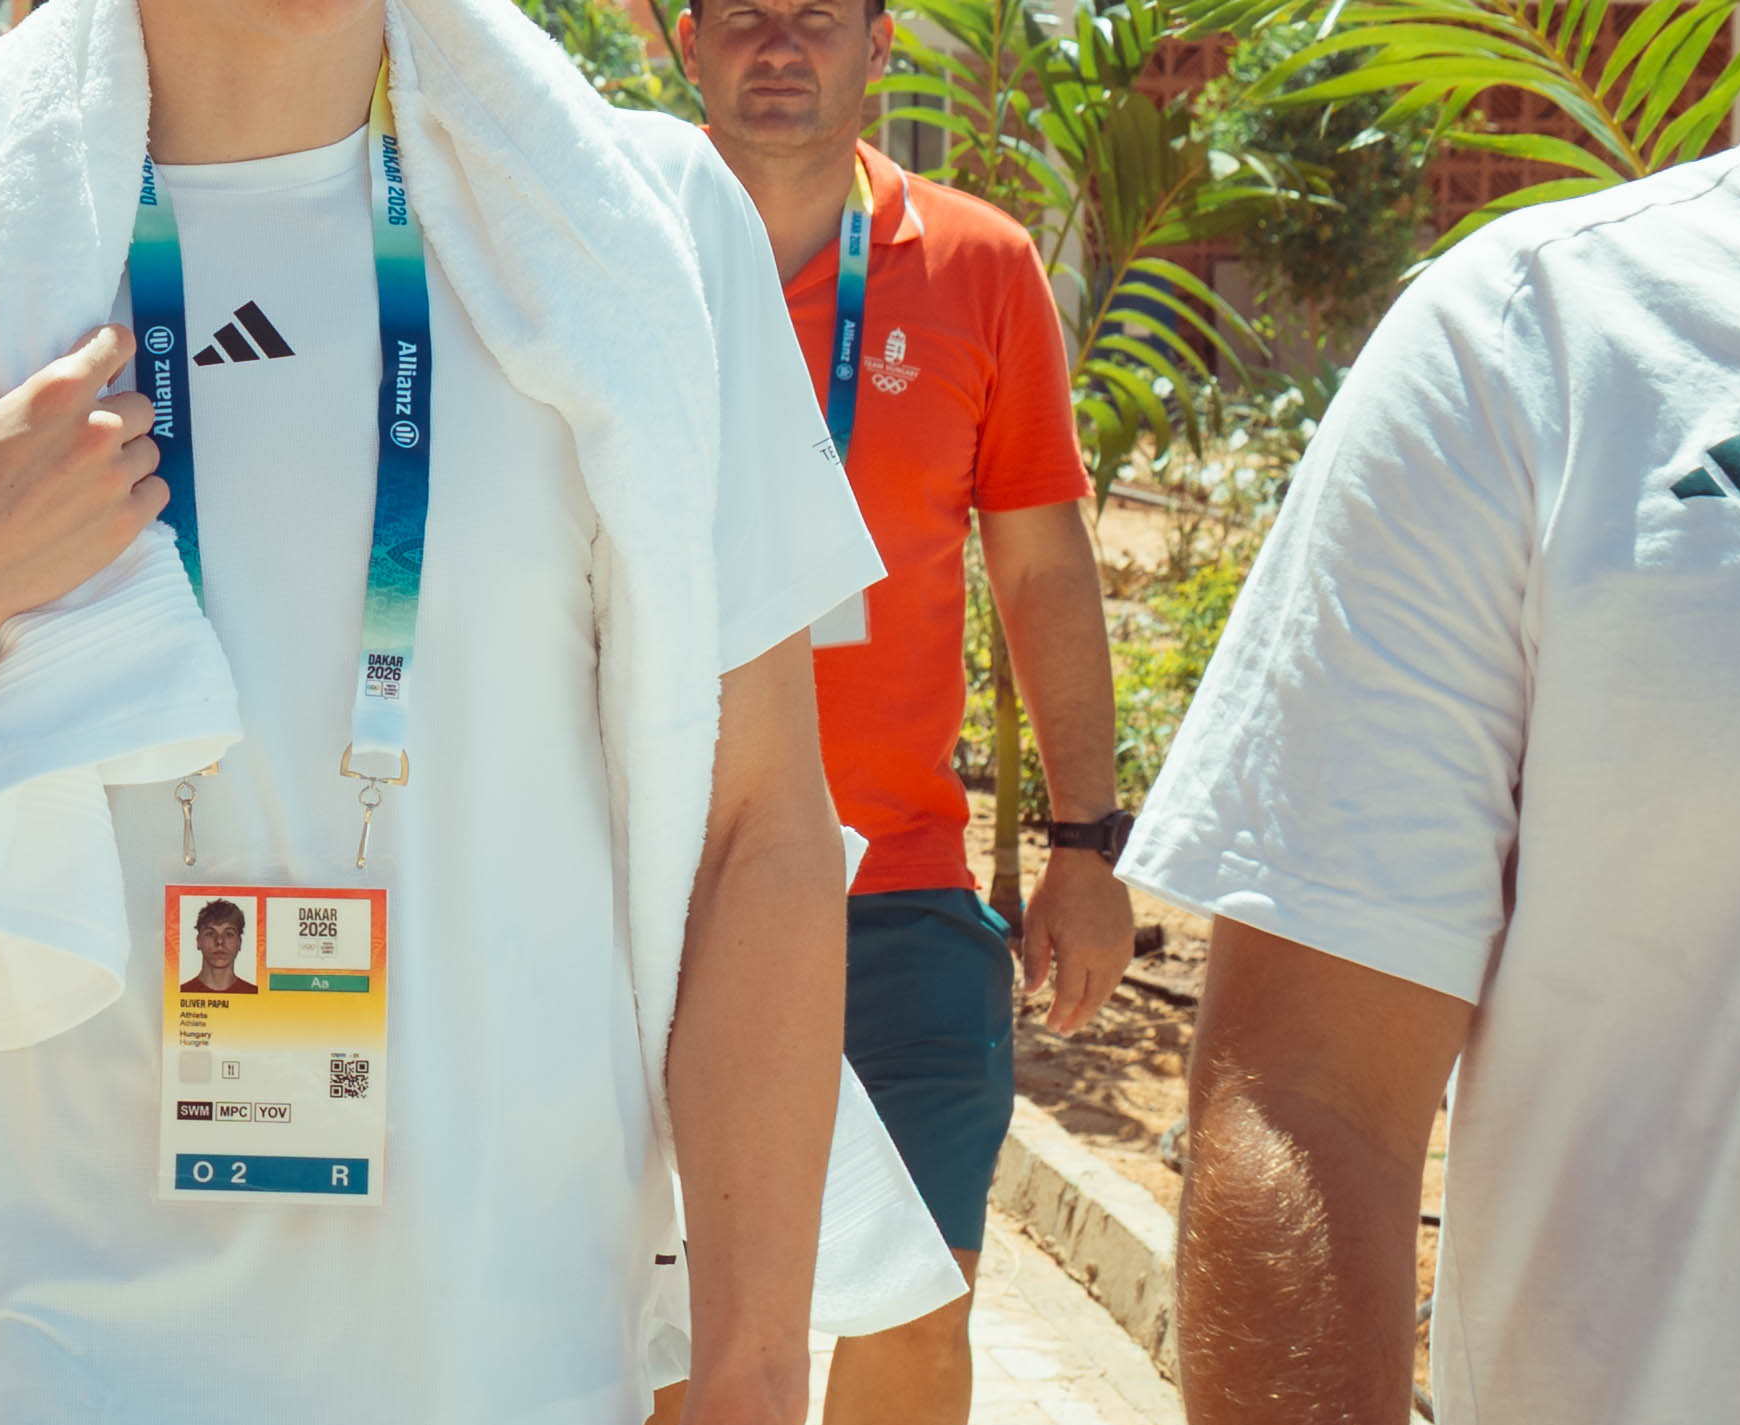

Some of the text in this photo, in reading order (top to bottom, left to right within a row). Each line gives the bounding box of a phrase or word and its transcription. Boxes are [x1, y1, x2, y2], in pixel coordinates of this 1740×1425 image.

[382, 134, 408, 226] DAKAR 2026
[840, 319, 856, 363] Allianz
[395, 340, 418, 416] Allianz
[154, 359, 175, 439] Allianz
[368, 653, 403, 667] DAKAR
[367, 666, 401, 681] 2026
[299, 908, 337, 921] DAKAR
[299, 922, 337, 937] 2026
[180, 1105, 287, 1119] SWM MPC YOV
[231, 1162, 247, 1184] 2
[331, 1165, 349, 1186] R
